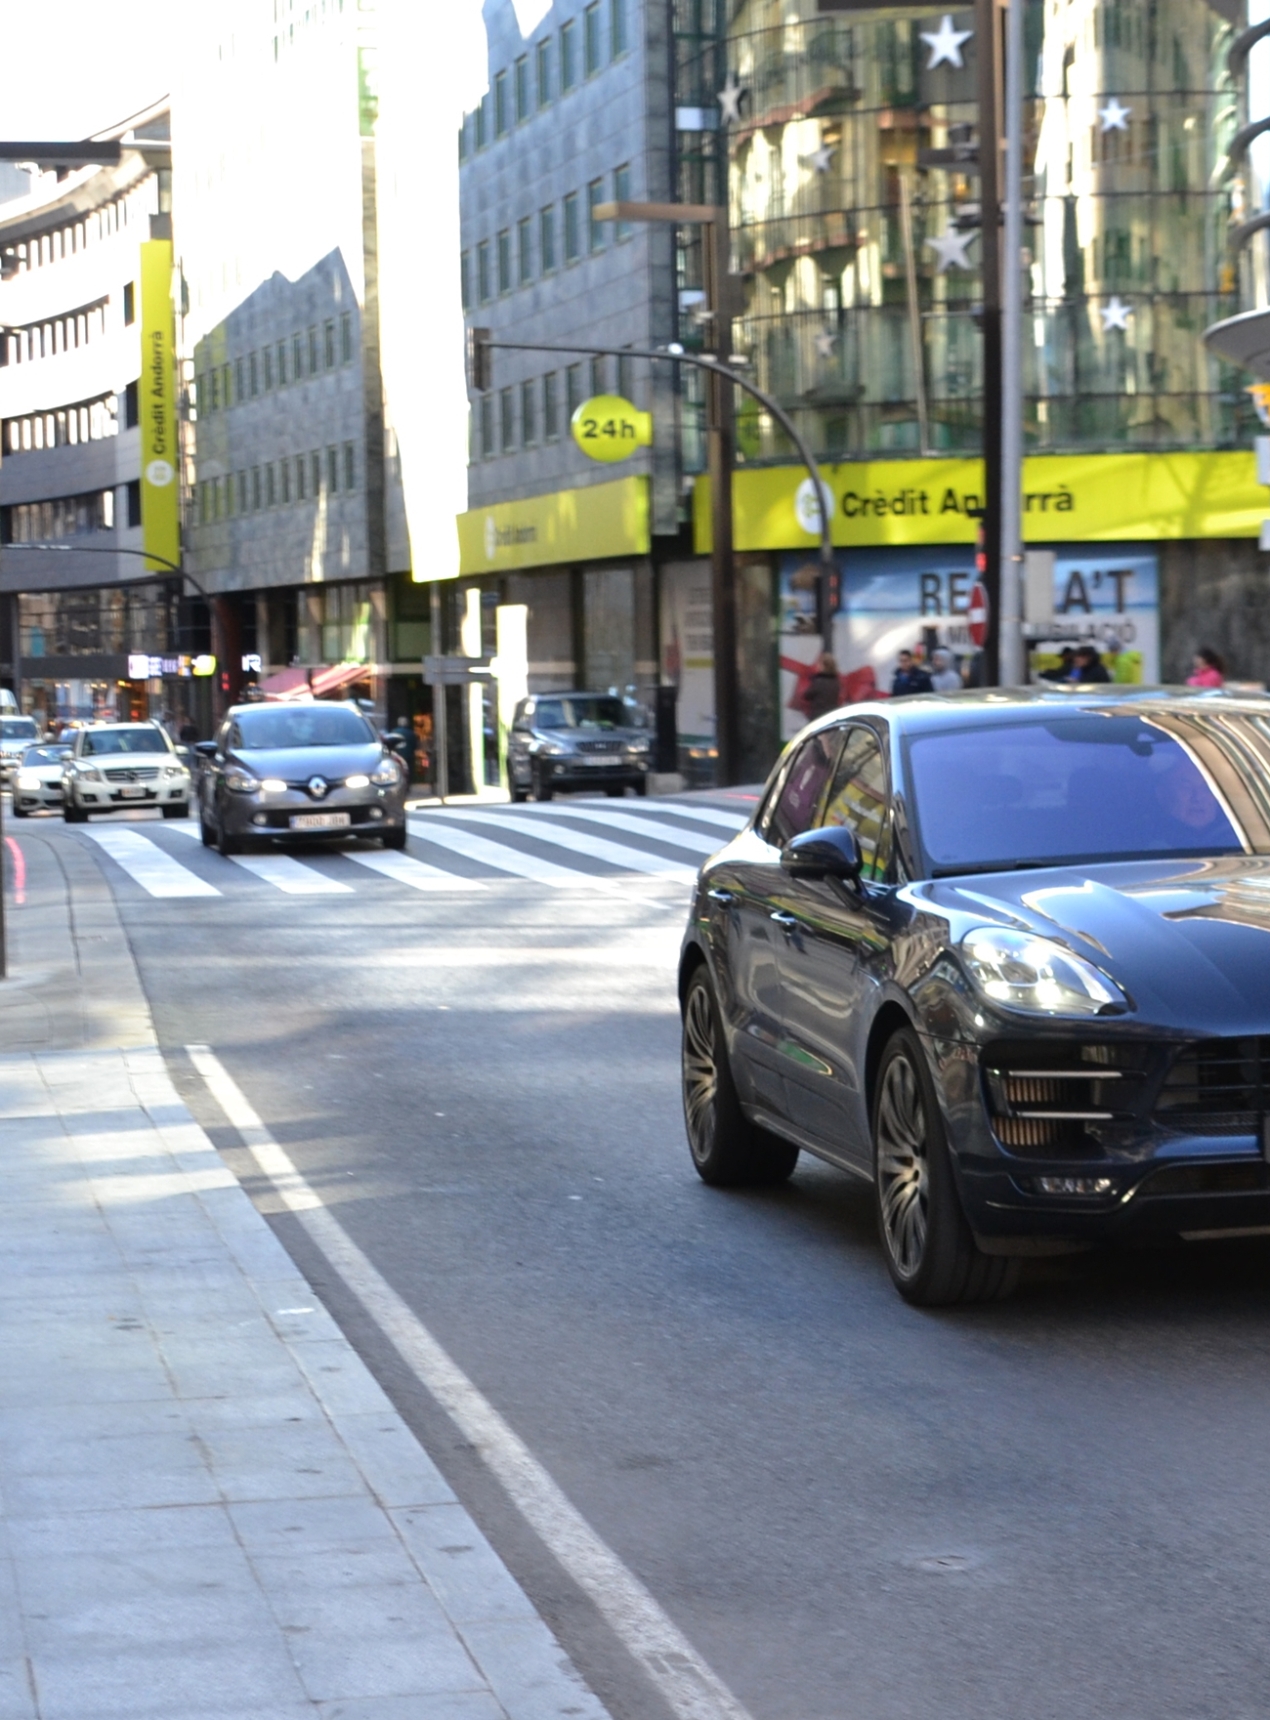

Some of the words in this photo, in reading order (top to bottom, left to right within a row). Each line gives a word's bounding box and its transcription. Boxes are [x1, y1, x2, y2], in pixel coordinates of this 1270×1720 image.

[582, 419, 636, 438] 24h
[842, 490, 929, 518] Crèdit
[940, 485, 1074, 515] Anrrà
